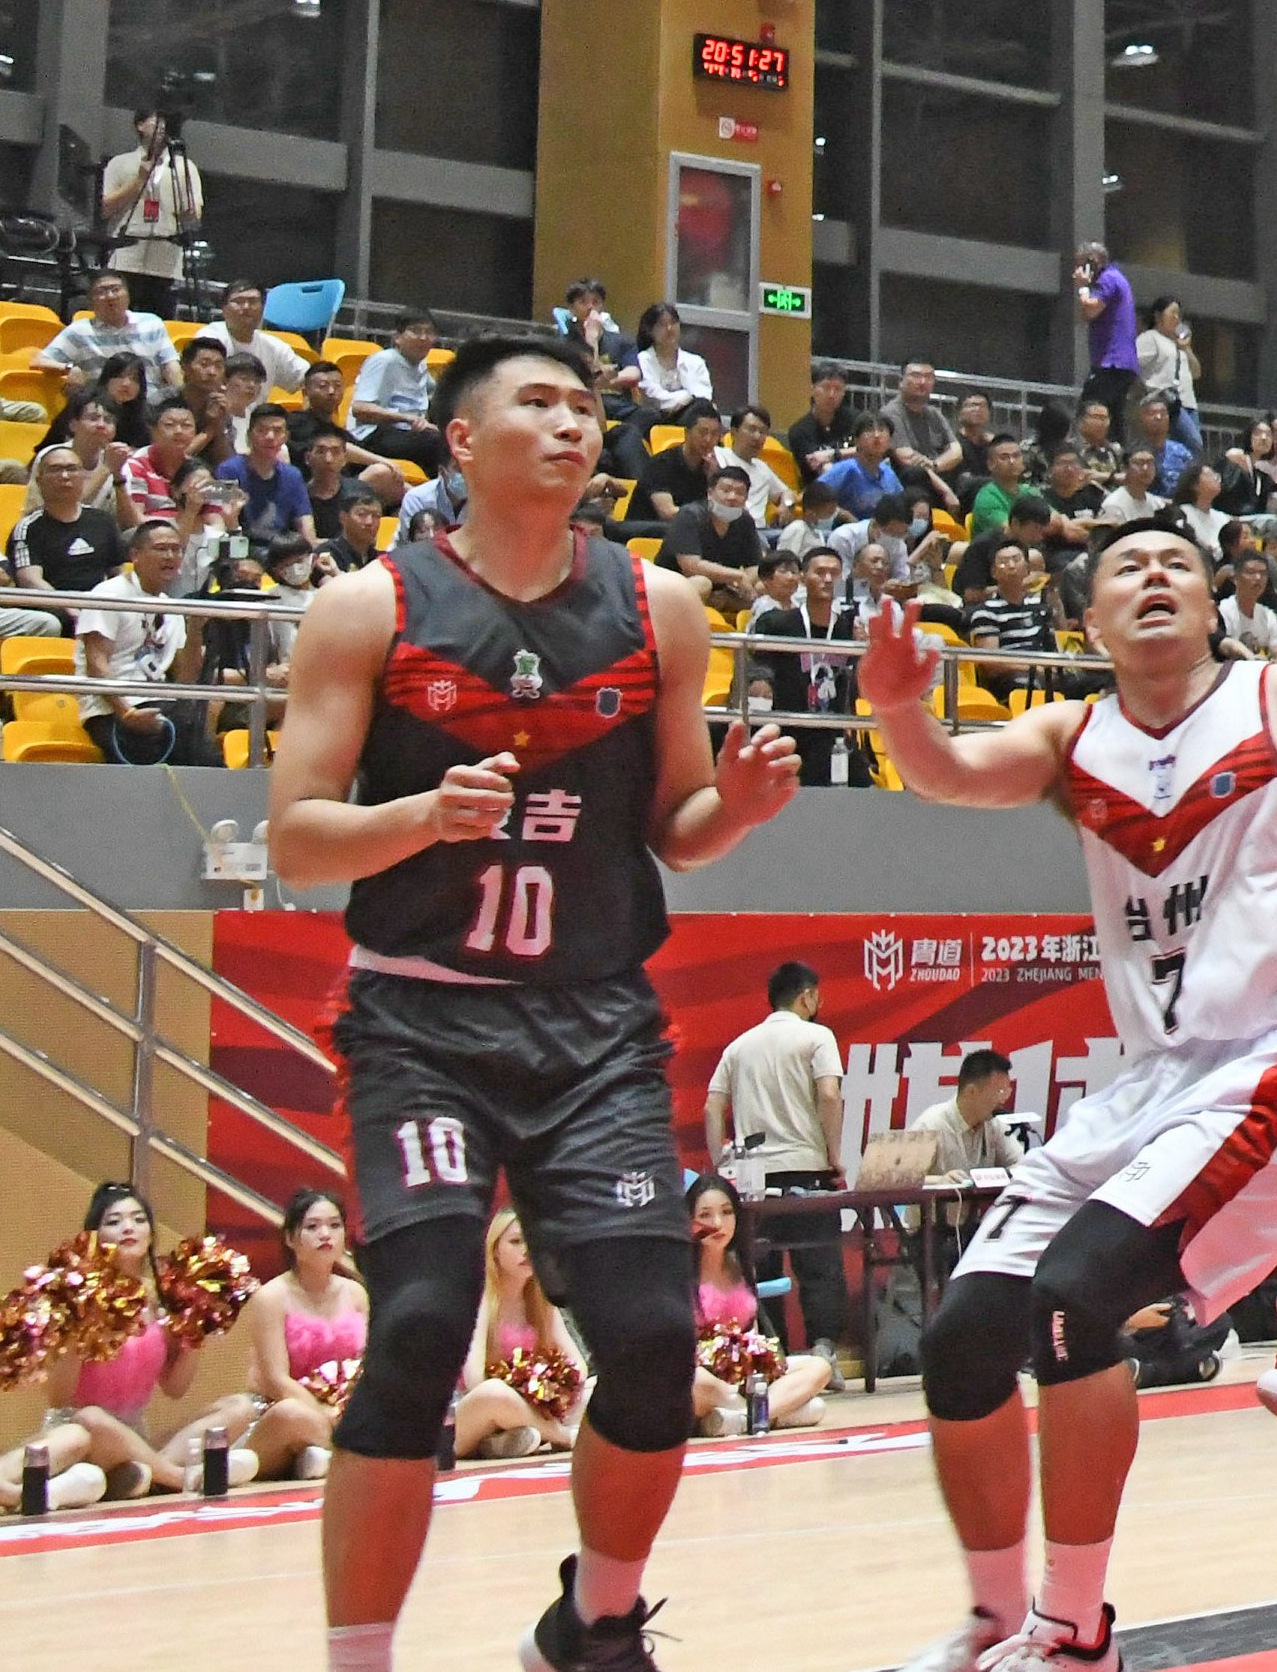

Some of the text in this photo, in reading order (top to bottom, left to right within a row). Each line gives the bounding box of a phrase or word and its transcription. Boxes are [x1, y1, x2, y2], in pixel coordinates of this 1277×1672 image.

[702, 39, 785, 72] 20:51:27
[466, 864, 555, 956] 10
[910, 967, 961, 982] ZHOUDAO
[981, 967, 1010, 982] 2023
[1017, 967, 1072, 984] ZHEJIANG
[1151, 947, 1186, 1034] 7
[397, 1116, 468, 1188] 10
[983, 1193, 1032, 1243] 7
